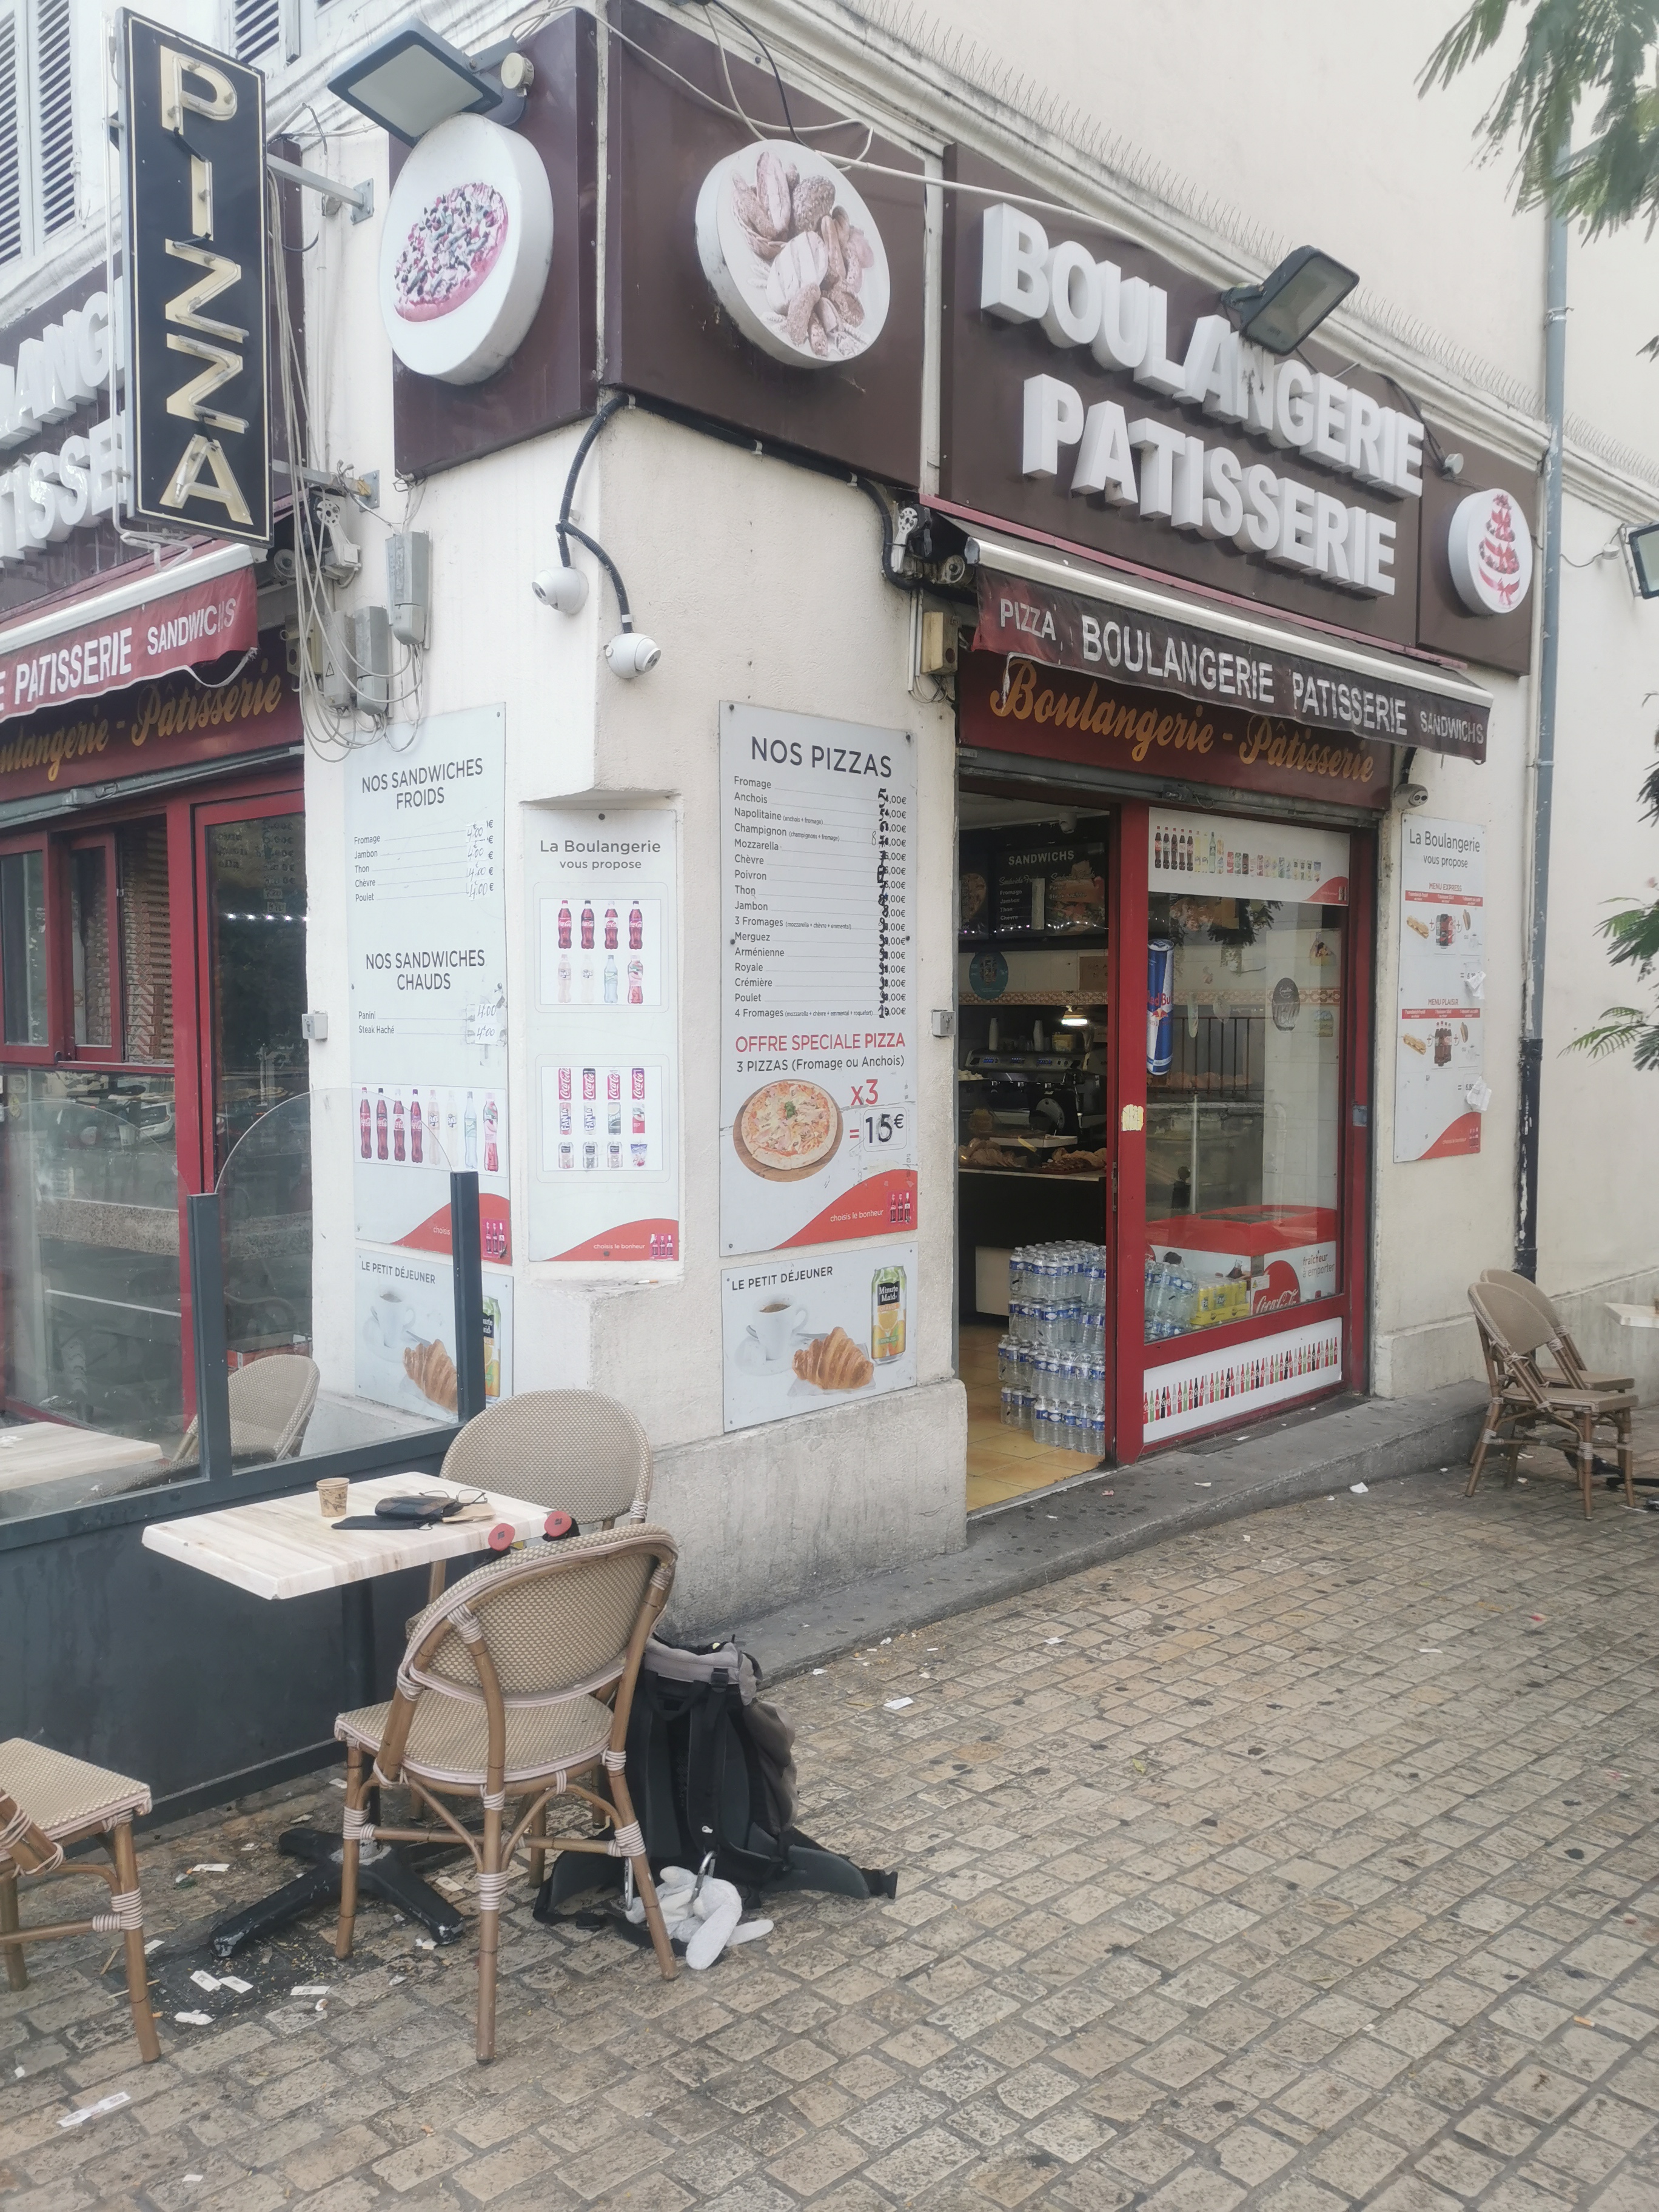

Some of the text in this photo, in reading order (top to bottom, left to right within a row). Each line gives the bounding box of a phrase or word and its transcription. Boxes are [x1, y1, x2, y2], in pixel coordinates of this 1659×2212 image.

[159, 45, 254, 526] PIZZA
[980, 202, 1424, 499] BOULANGERIE
[0, 276, 124, 450] ANG
[1022, 374, 1396, 598] PATISSERIE
[15, 628, 132, 705] PATISSERIE
[999, 598, 1484, 745] PIZZA BOULANGERIE PATISSERIE SANDWICHS
[990, 659, 1213, 762] Boulangerie
[1239, 715, 1374, 783] Pâtisserie
[752, 736, 892, 777] NOS PIZZAS
[363, 758, 483, 793] NOS SANDWICHES
[734, 776, 771, 789] Fromage
[397, 787, 444, 809] FROIDS
[734, 792, 768, 804] Anchois
[734, 807, 782, 820] Napolitaine
[734, 823, 786, 837] Champignon
[354, 834, 380, 845] Fromage
[734, 838, 779, 851] Mozzarella
[1409, 828, 1480, 853] La Boulangerie
[540, 840, 661, 855] La Boulangerie
[354, 850, 378, 859] Jambon
[735, 854, 764, 865] Chèvre
[1008, 850, 1074, 866] SANDWICHS
[592, 861, 642, 870] propose
[1423, 855, 1468, 869] vous propose
[355, 865, 369, 873] Thon
[735, 870, 766, 880] Poivron
[355, 878, 375, 888] Chèvre
[1429, 882, 1462, 892] MENU EXPRESS
[735, 885, 756, 895] Thon
[355, 893, 374, 902] Poulet
[735, 901, 768, 911] Jambon
[735, 916, 740, 925] 3
[743, 917, 783, 928] Fromages
[735, 932, 771, 942] Merguez
[735, 947, 785, 957] Arménienne
[366, 950, 485, 970] NOS SANDWICHES
[735, 962, 763, 972] Royale
[397, 973, 451, 990] CHAUDS
[735, 977, 773, 987] Crémière
[735, 993, 762, 1002] Poulet
[358, 1011, 376, 1019] Panini
[743, 1008, 783, 1018] Fromages
[358, 1025, 375, 1034] Steak
[377, 1025, 395, 1034] Haché
[736, 1033, 905, 1053] OFFRE SPECIALE PIZZA
[737, 1061, 743, 1072] 3
[747, 1060, 788, 1071] PIZZAS
[792, 1058, 843, 1072] (Fromage
[862, 1055, 905, 1067] Anchois)
[830, 1213, 851, 1222] choisis
[859, 1209, 883, 1219] bonheur
[434, 1226, 451, 1235] choisis
[1304, 1254, 1328, 1265] fraîcheur
[362, 1261, 435, 1284] LE PETIT DÉJEUNER
[1309, 1264, 1335, 1277] emporter
[732, 1265, 833, 1291] LE PETIT DÉJEUNER
[879, 1286, 898, 1295] Minute
[882, 1293, 896, 1302] Maid
